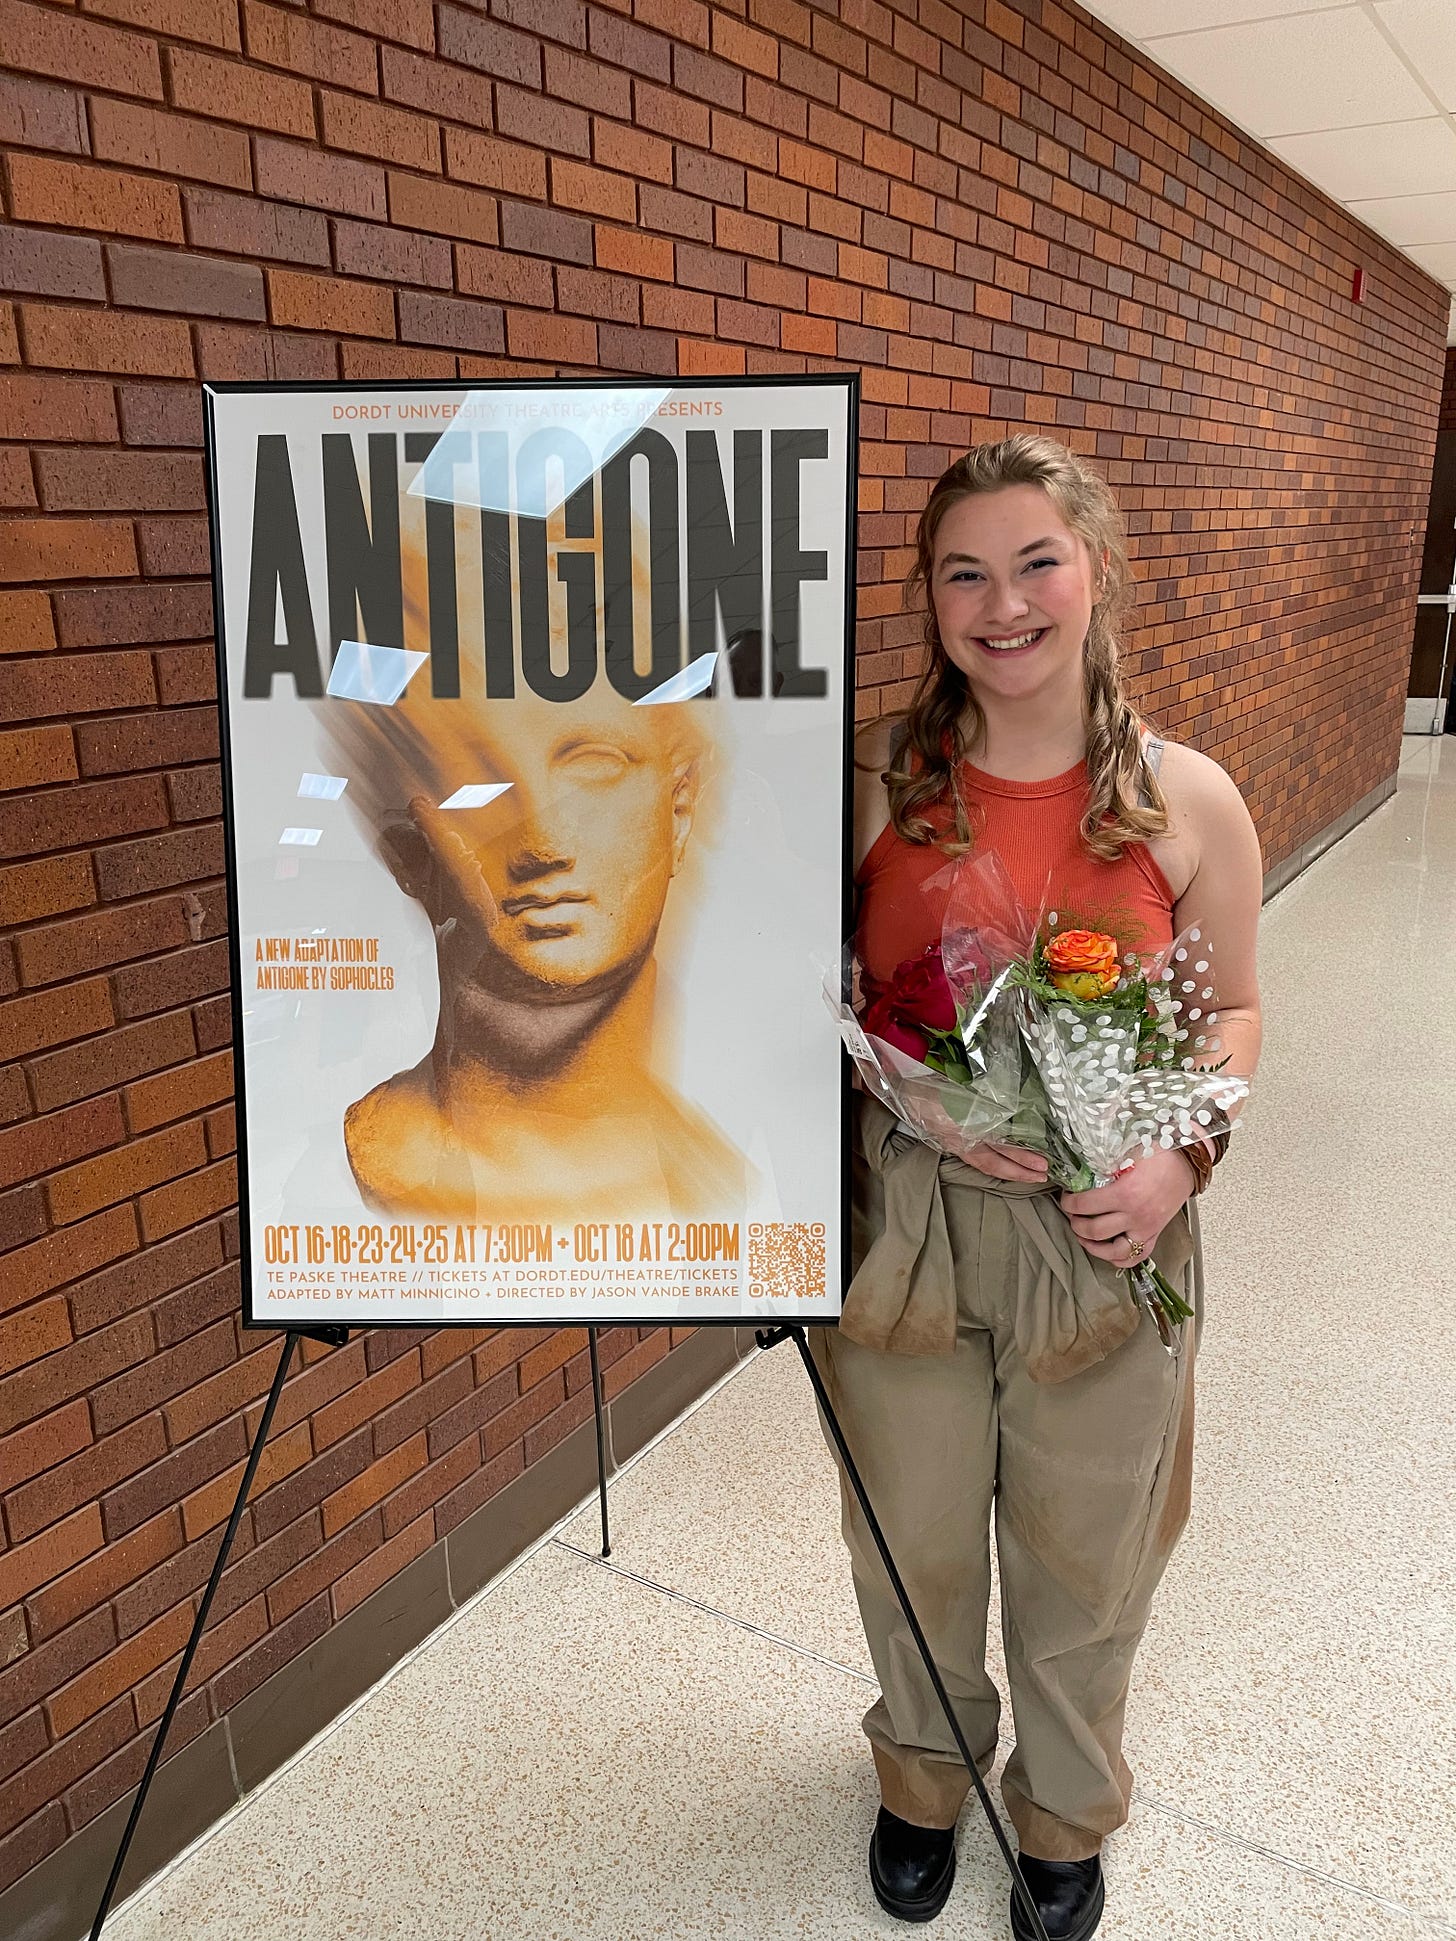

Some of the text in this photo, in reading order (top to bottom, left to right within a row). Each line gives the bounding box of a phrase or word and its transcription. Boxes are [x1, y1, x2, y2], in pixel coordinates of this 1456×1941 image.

[332, 401, 723, 420] DORDT UNIVERSITY THEATRE ARTS PRESENTS
[241, 426, 829, 703] ANTIGONE
[255, 938, 380, 962] A NEW ADAPTATION OF
[256, 966, 395, 990] ANTIGONE BY SOPHOCLES
[264, 1225, 300, 1264] OCT
[453, 1224, 477, 1263] AT
[482, 1223, 553, 1263] 7:30PM
[574, 1223, 610, 1263] OCT
[614, 1223, 634, 1262] 18
[639, 1223, 663, 1262] AT
[667, 1223, 740, 1262] 2:00PM
[267, 1271, 284, 1283] TE
[289, 1271, 335, 1283] PASKE
[341, 1271, 407, 1283] THEATRE
[428, 1270, 487, 1283] TICKETS
[492, 1270, 510, 1282] AT
[515, 1268, 738, 1282] DORDT.EDU/THEATRE/TICKETS
[267, 1288, 331, 1300] ADAPTED
[336, 1288, 353, 1300] BY
[358, 1288, 395, 1299] MATT
[400, 1287, 480, 1299] MINNICINO
[497, 1287, 565, 1298] DIRECTED
[570, 1287, 587, 1298] BY
[592, 1286, 636, 1299] JASON
[641, 1286, 690, 1297] VANDE
[695, 1286, 739, 1297] BRAKE
